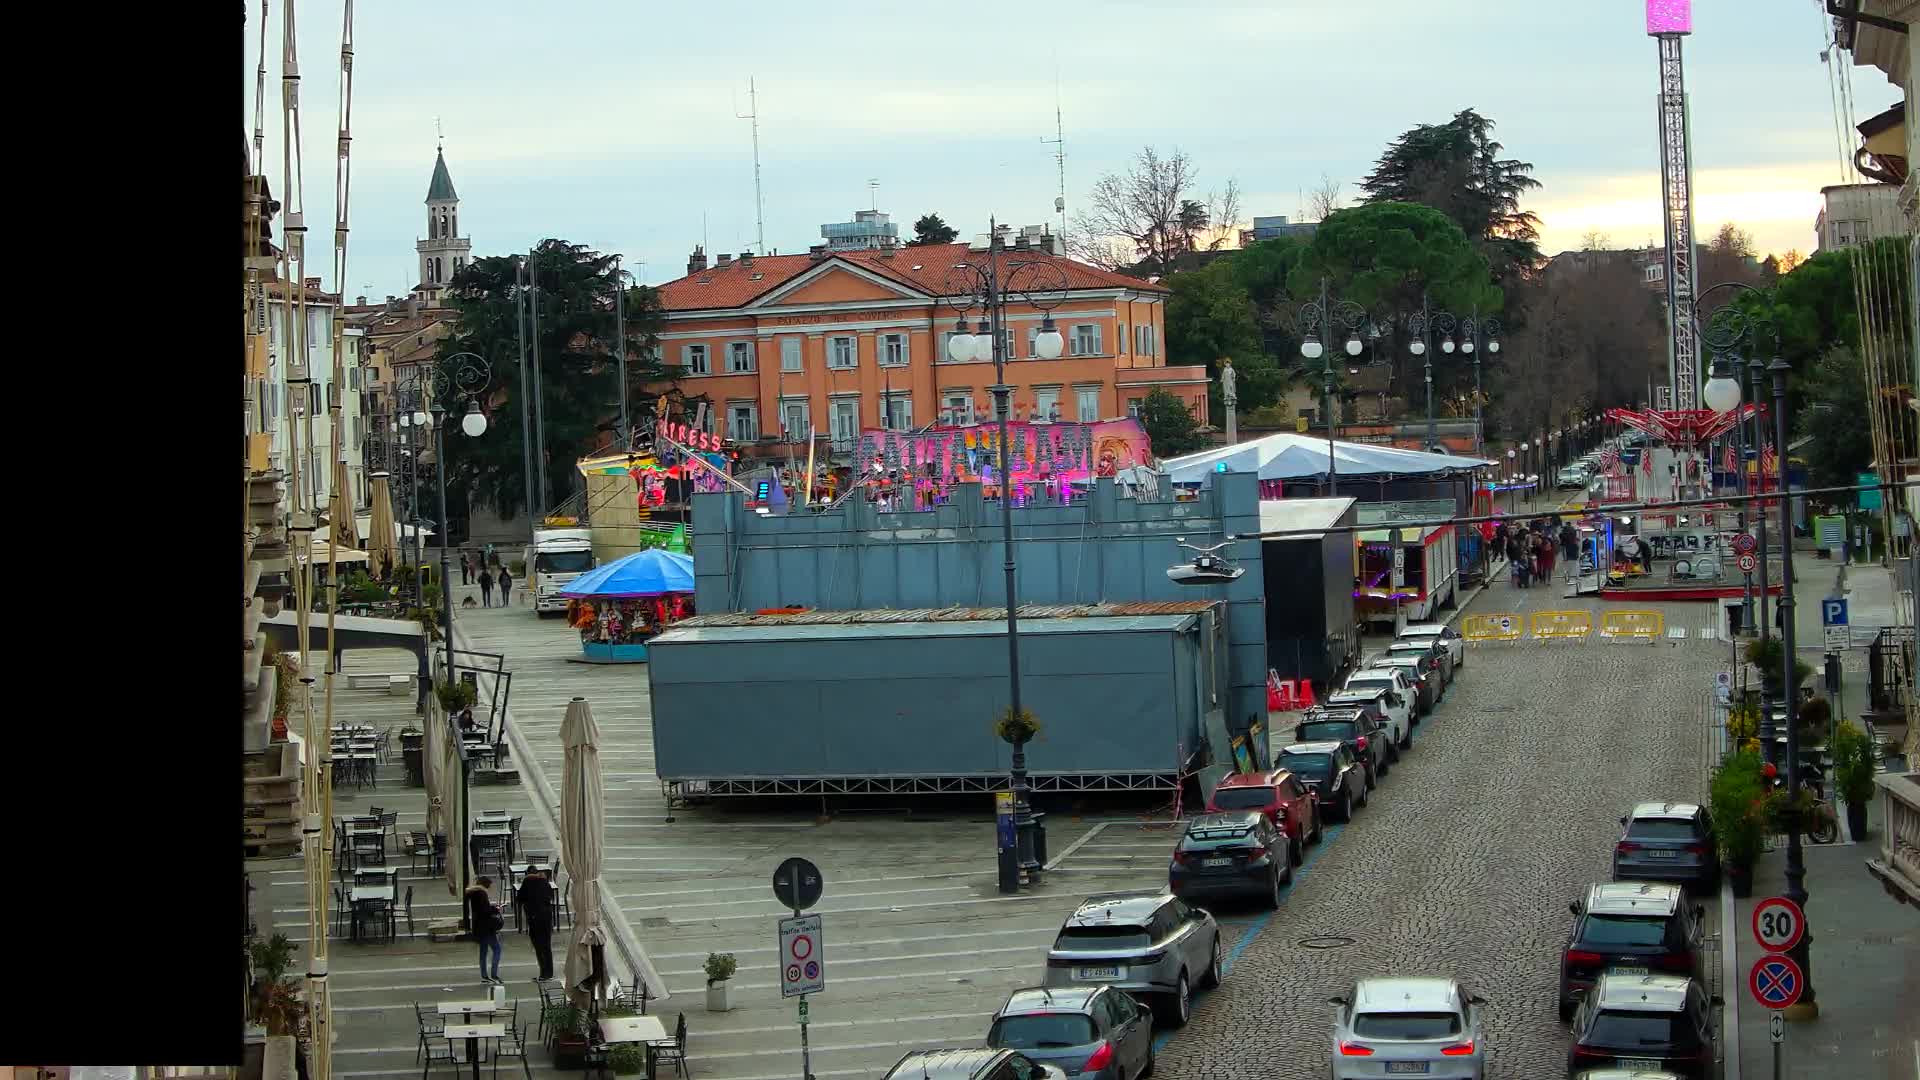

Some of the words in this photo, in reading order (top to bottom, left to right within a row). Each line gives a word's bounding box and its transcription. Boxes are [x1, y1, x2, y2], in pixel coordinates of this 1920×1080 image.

[1742, 558, 1752, 567] 20
[1827, 602, 1842, 622] P
[1762, 912, 1792, 938] 30
[790, 969, 798, 978] 20
